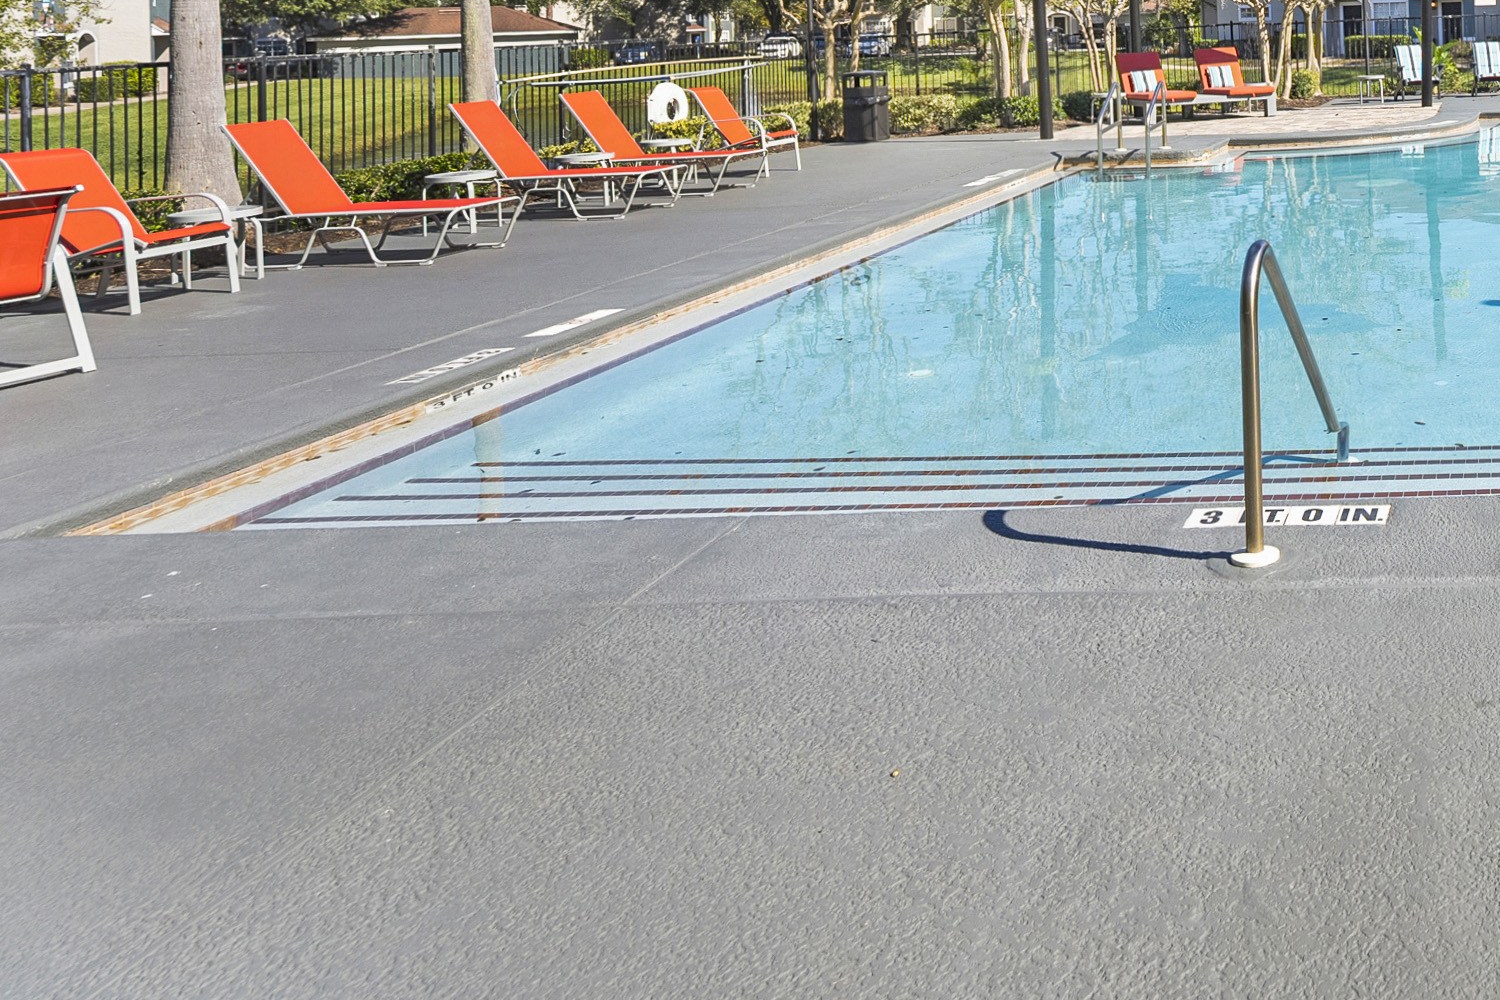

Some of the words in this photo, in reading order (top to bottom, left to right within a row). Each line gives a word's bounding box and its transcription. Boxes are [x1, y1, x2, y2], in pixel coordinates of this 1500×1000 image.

[432, 400, 446, 410] 3
[1199, 510, 1224, 525] 3
[1238, 508, 1285, 524] T.
[1301, 508, 1324, 522] 0
[1339, 507, 1384, 522] IN.
